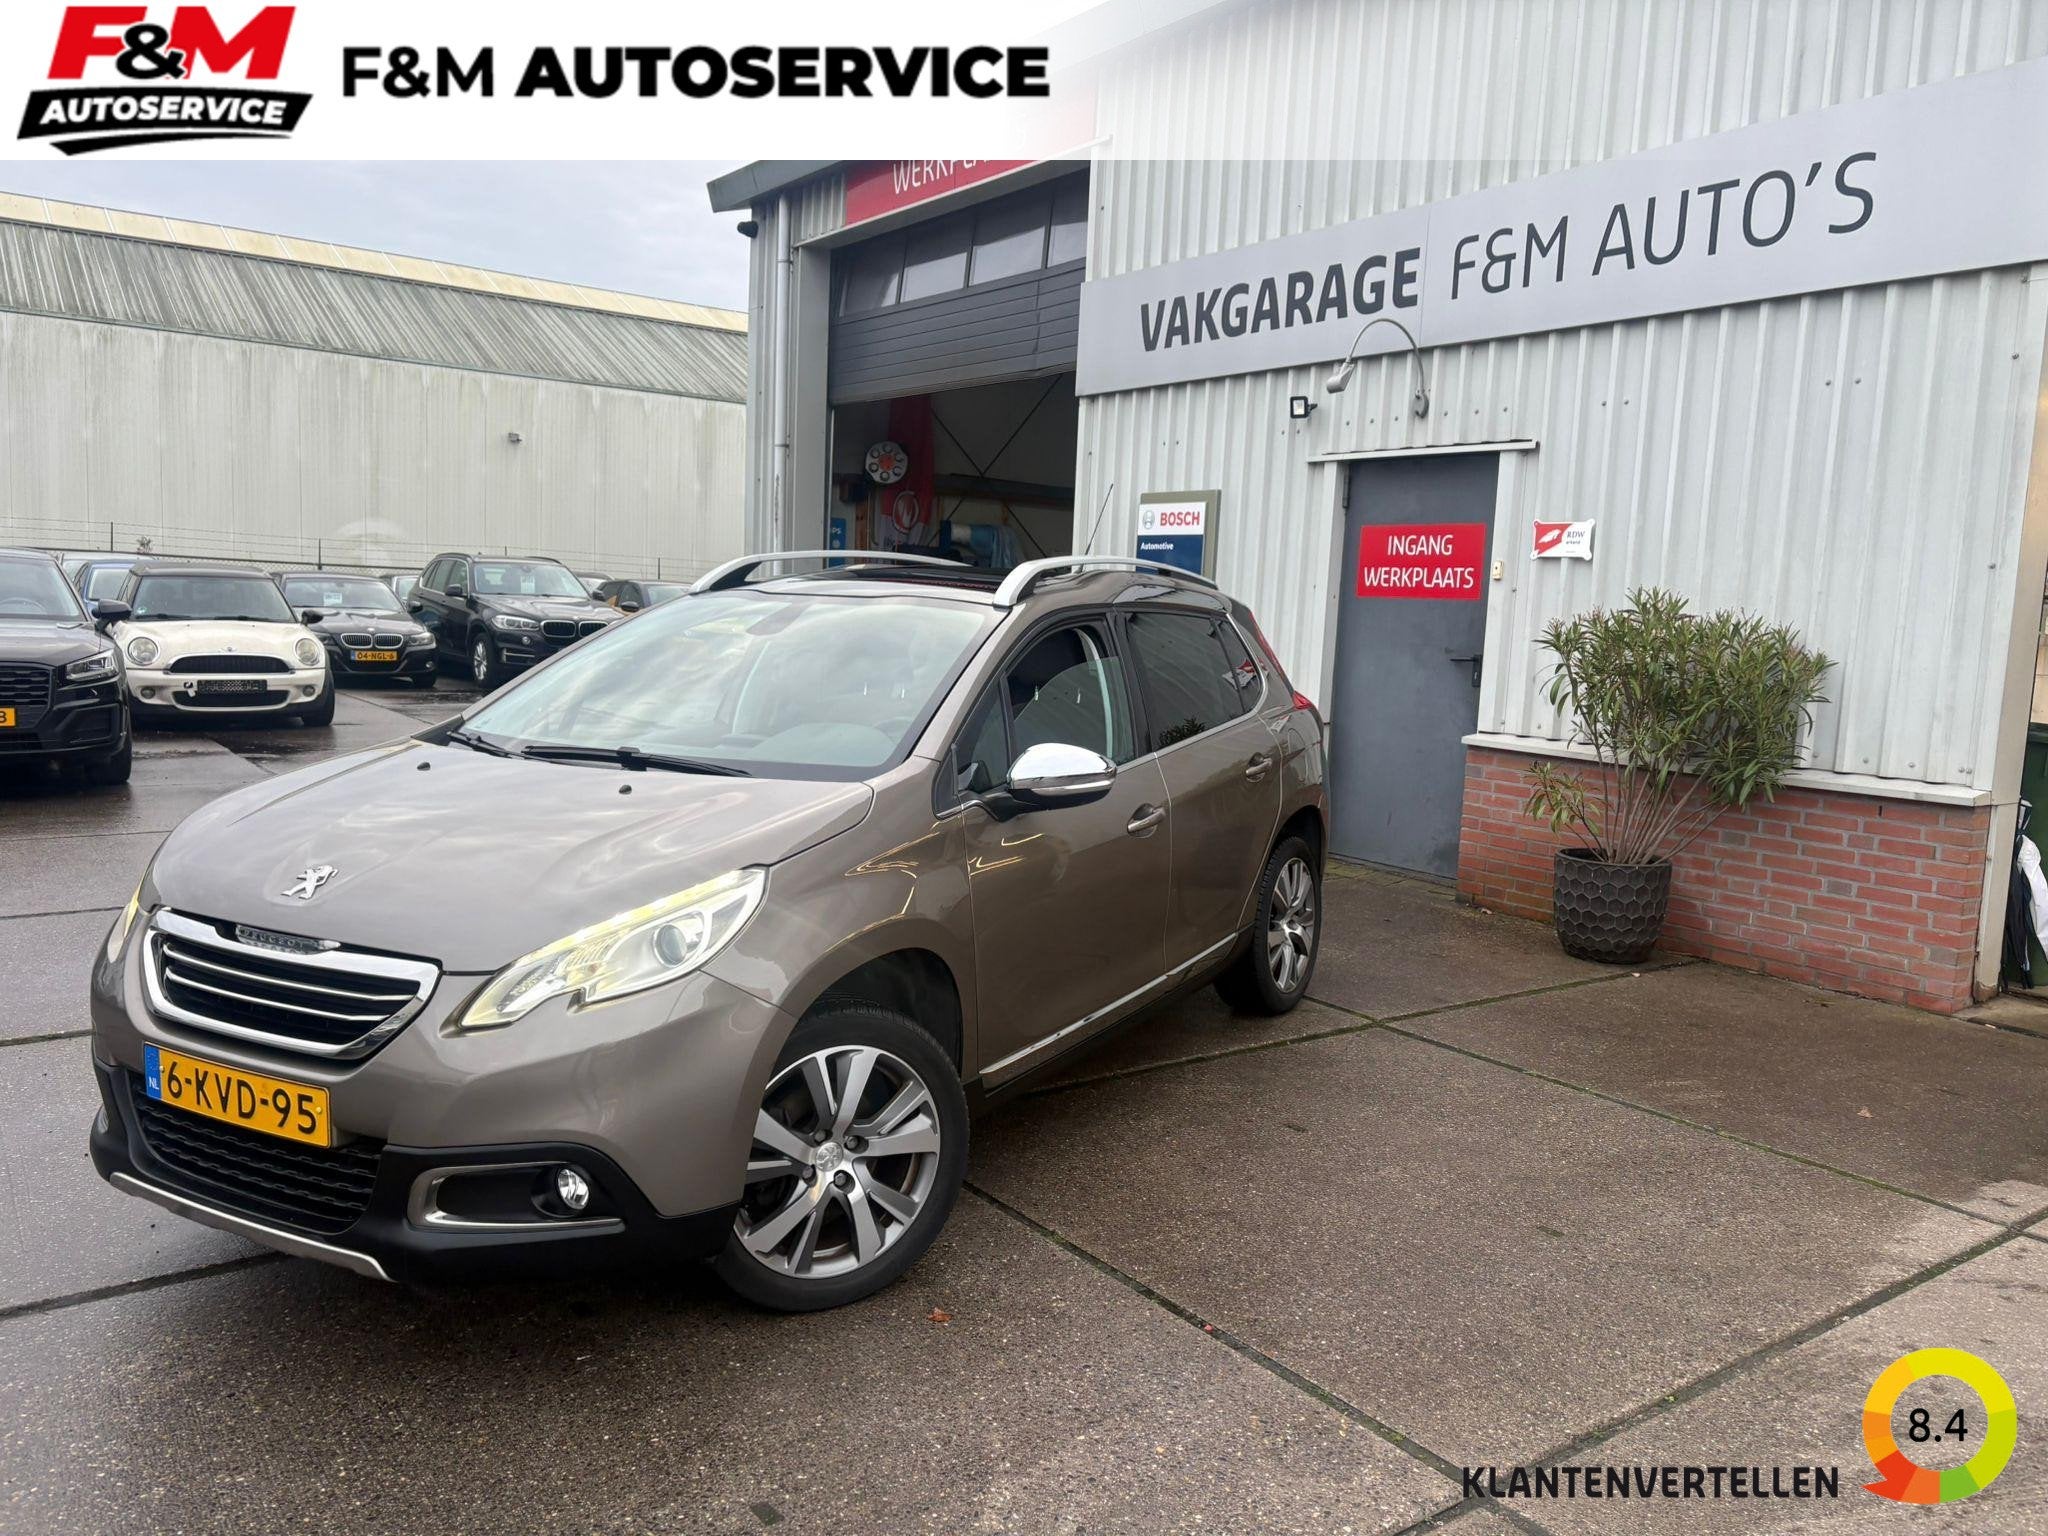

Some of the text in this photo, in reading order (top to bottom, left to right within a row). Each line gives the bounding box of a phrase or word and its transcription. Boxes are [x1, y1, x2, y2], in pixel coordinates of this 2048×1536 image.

[1140, 152, 1877, 352] VAKGARAGE F&M AUTO'S
[1160, 511, 1200, 526] BOSCH
[1140, 541, 1174, 551] Automotive
[1387, 534, 1453, 556] INGANG
[1363, 566, 1475, 589] WERKPLAATS
[148, 1076, 160, 1091] NL
[167, 1061, 317, 1135] 6-KVD-95
